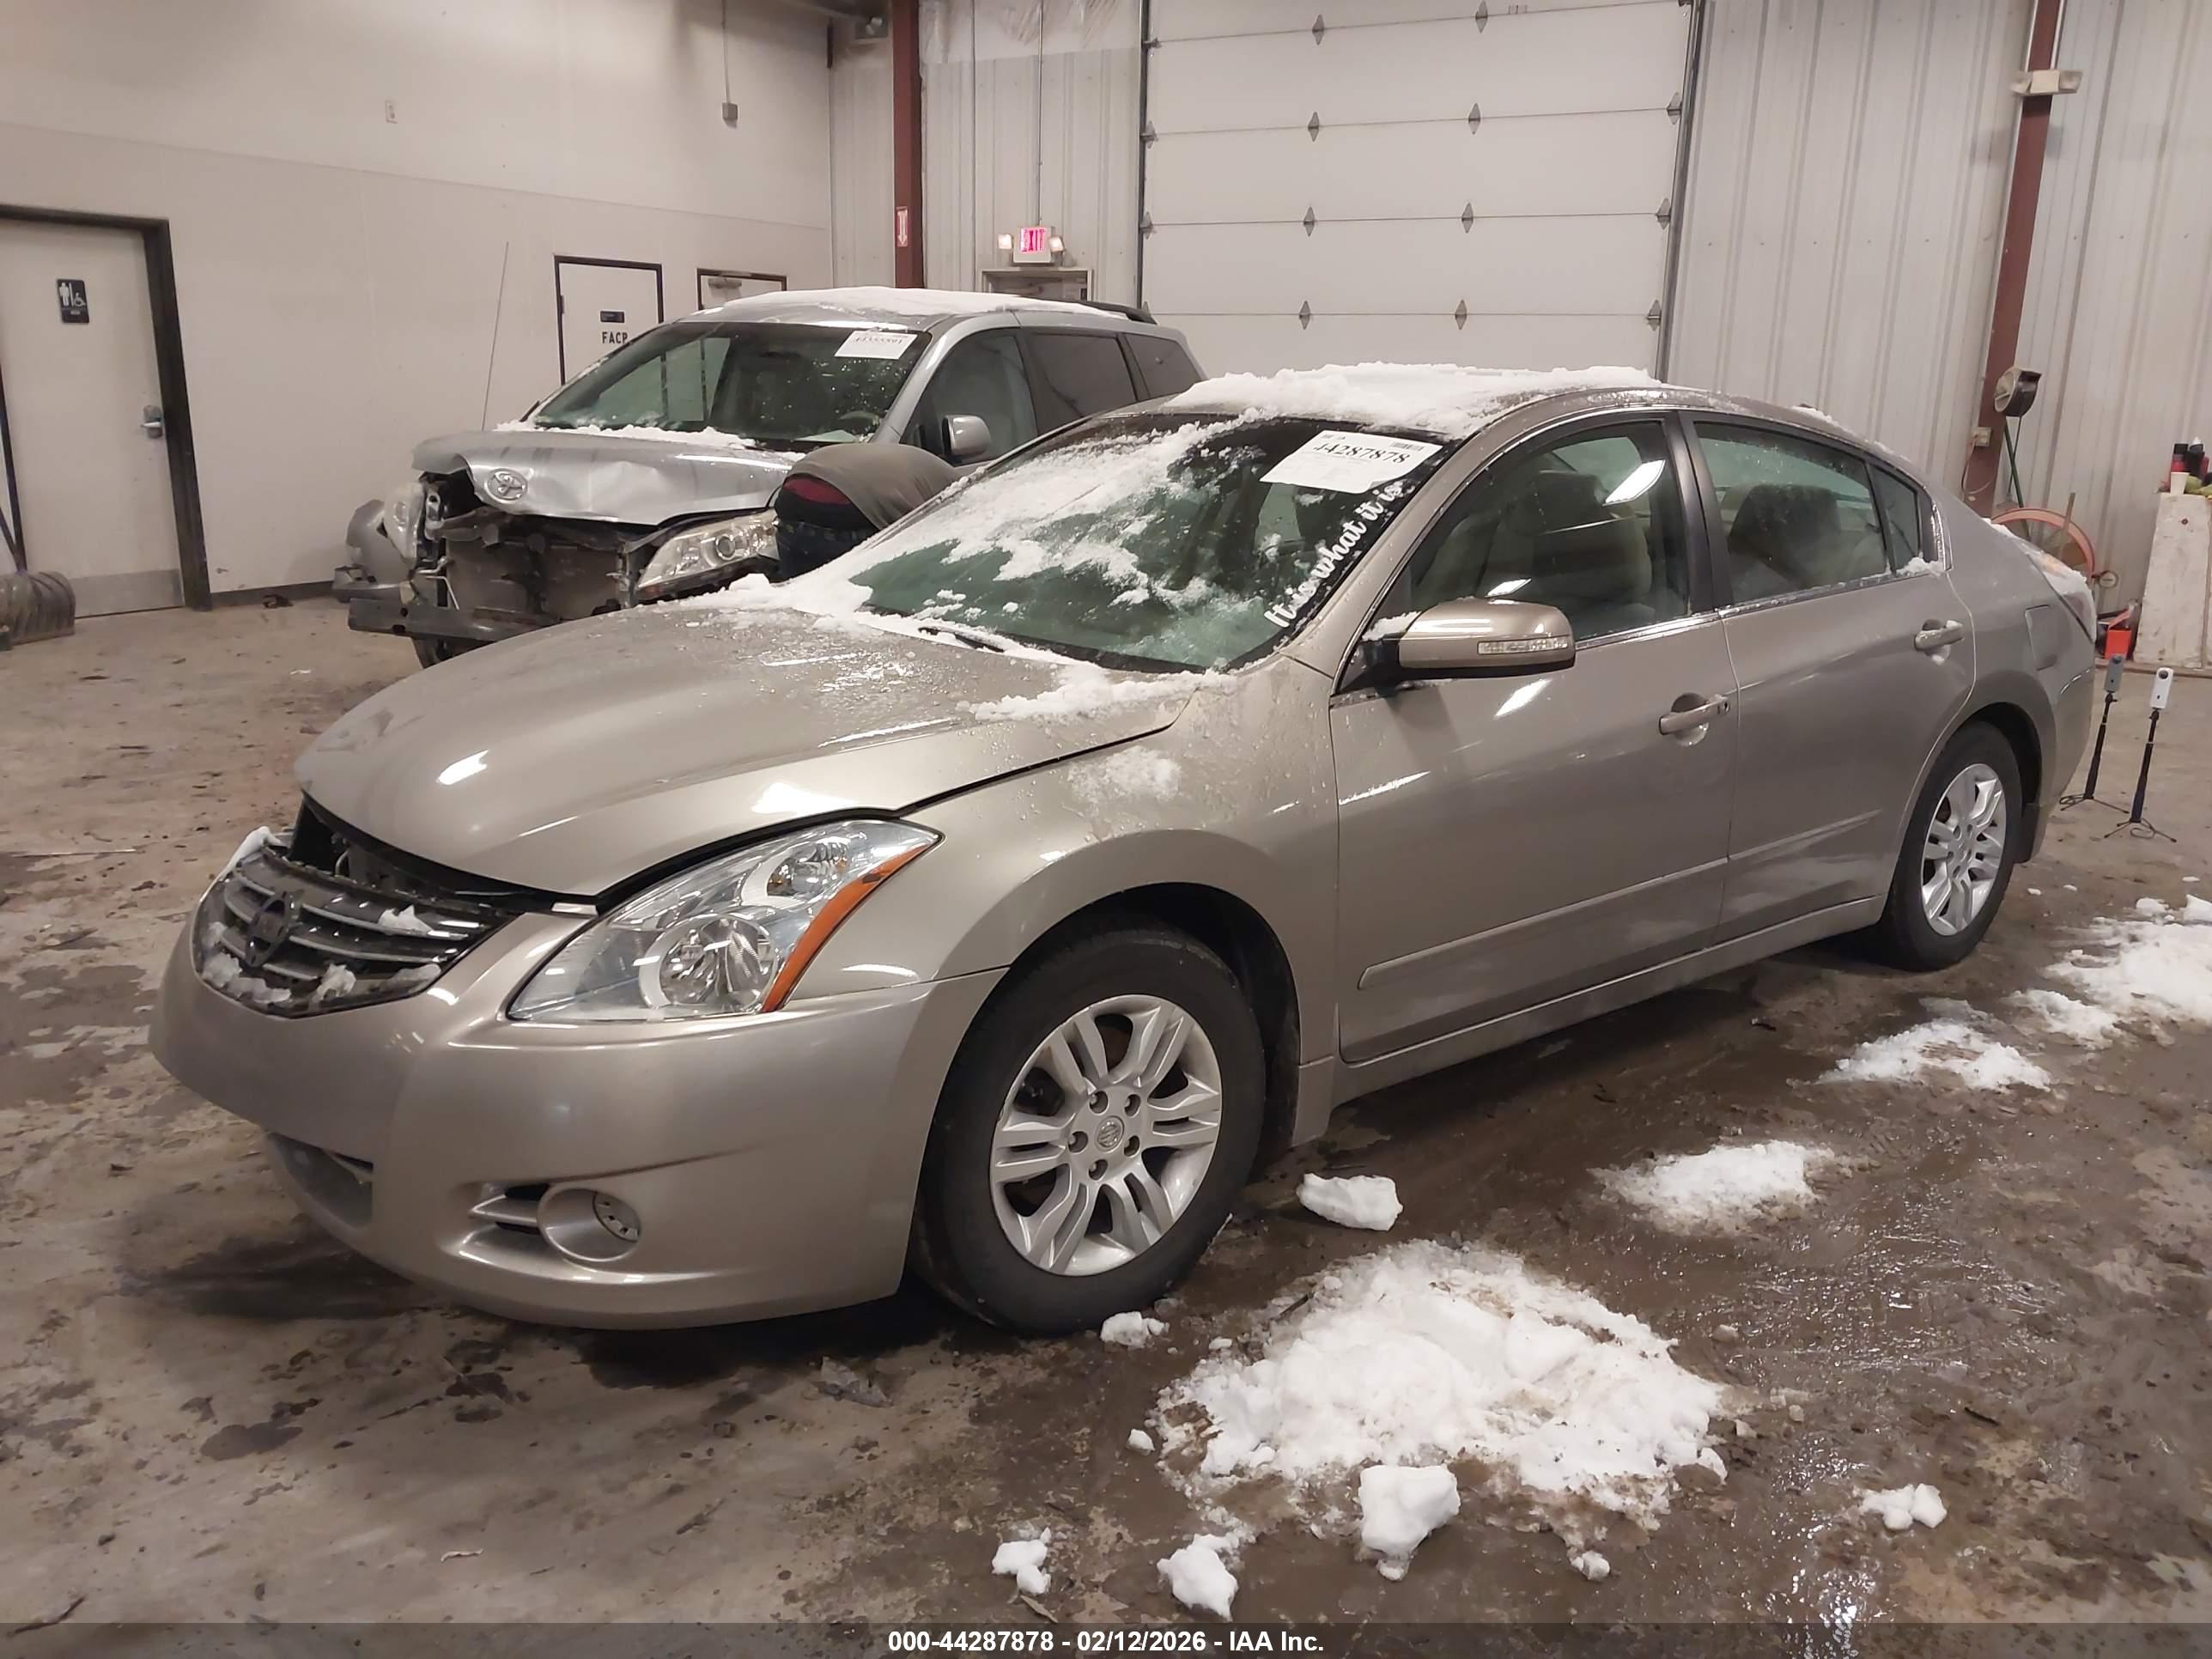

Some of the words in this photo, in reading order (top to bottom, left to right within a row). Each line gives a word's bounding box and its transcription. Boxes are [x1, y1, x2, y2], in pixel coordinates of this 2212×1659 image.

[1021, 228, 1045, 252] EXIT
[602, 331, 628, 344] FACP
[1264, 603, 1297, 628] It
[1310, 521, 1367, 578] what
[1355, 500, 1384, 521] it
[1373, 480, 1403, 503] is
